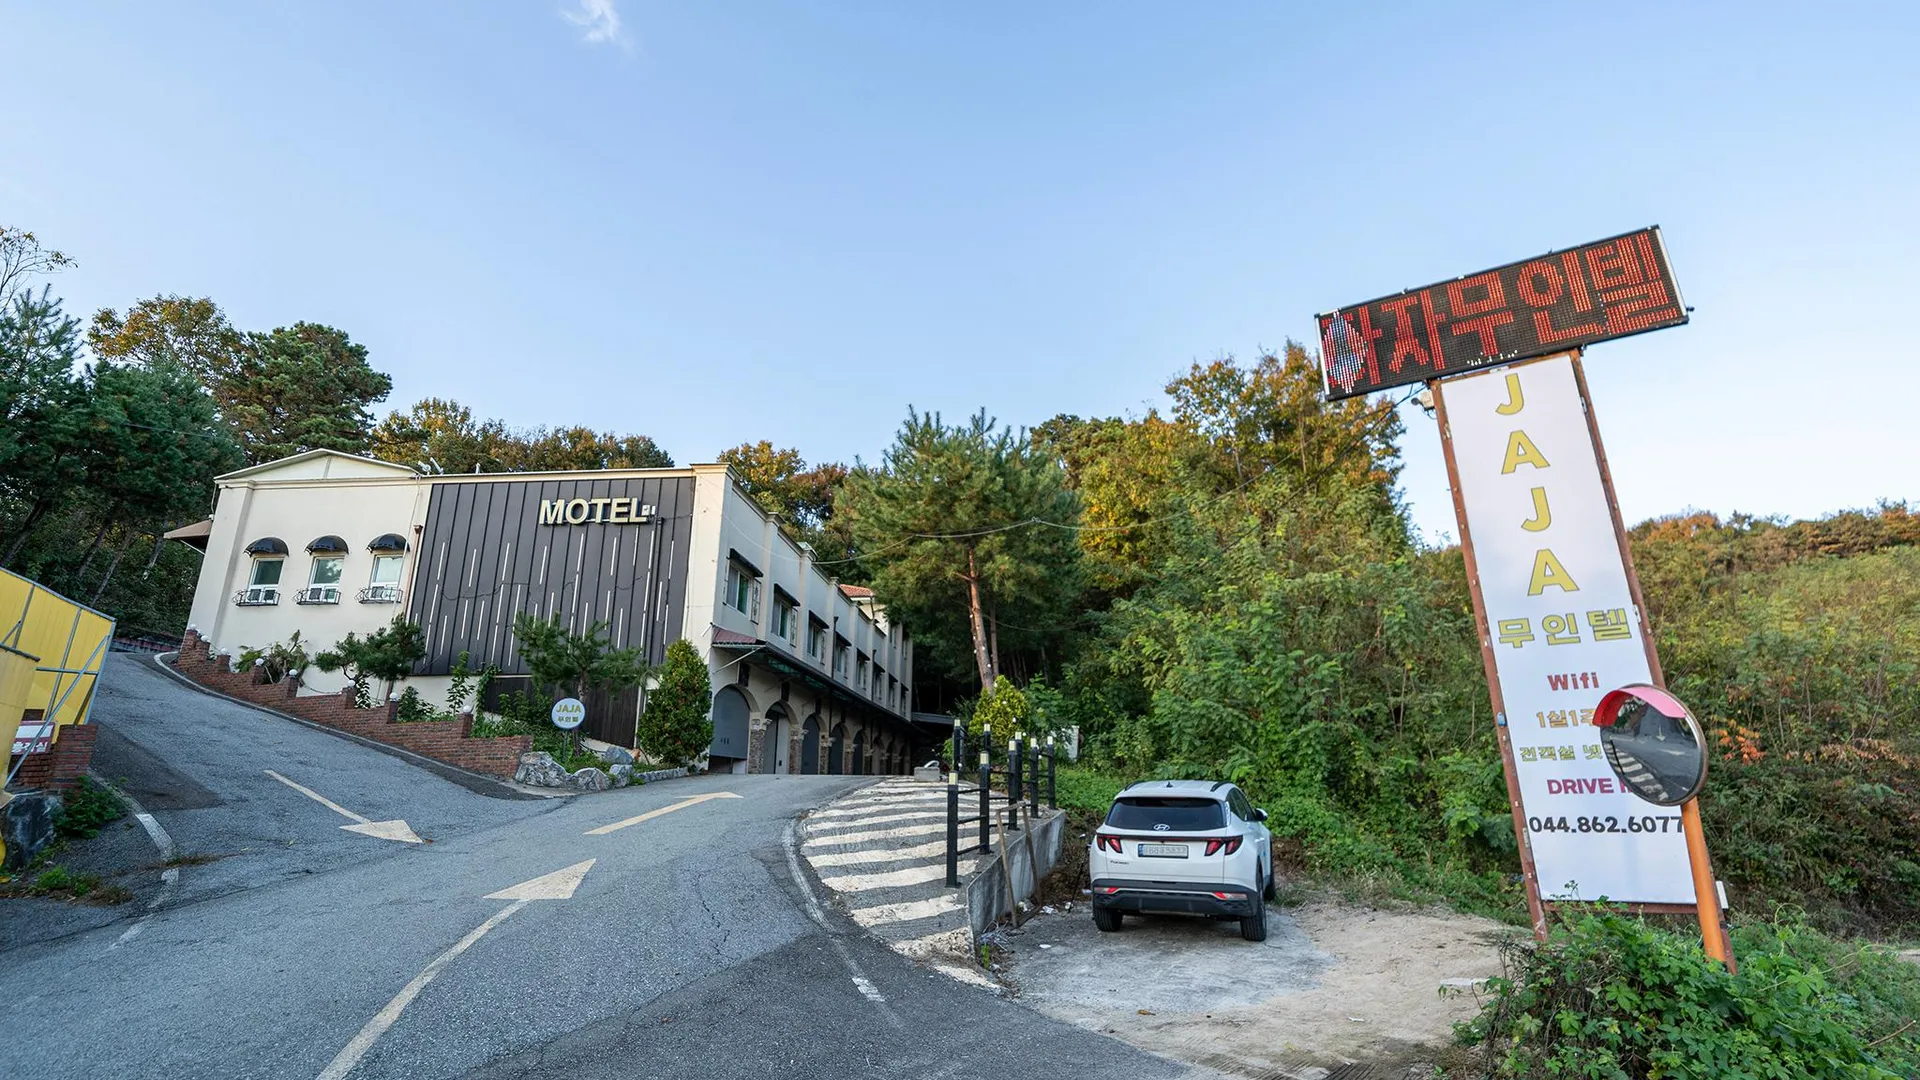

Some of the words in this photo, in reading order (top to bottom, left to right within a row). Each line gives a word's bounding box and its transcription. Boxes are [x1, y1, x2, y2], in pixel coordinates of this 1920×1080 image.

[539, 497, 648, 525] MOTEL
[1498, 608, 1632, 648] 무인텔
[1547, 672, 1600, 691] Wifi
[556, 704, 582, 713] JAJA
[1520, 745, 1576, 762] 전객실
[1547, 778, 1615, 795] DRIVE
[1528, 815, 1684, 834] 044.862.6077
